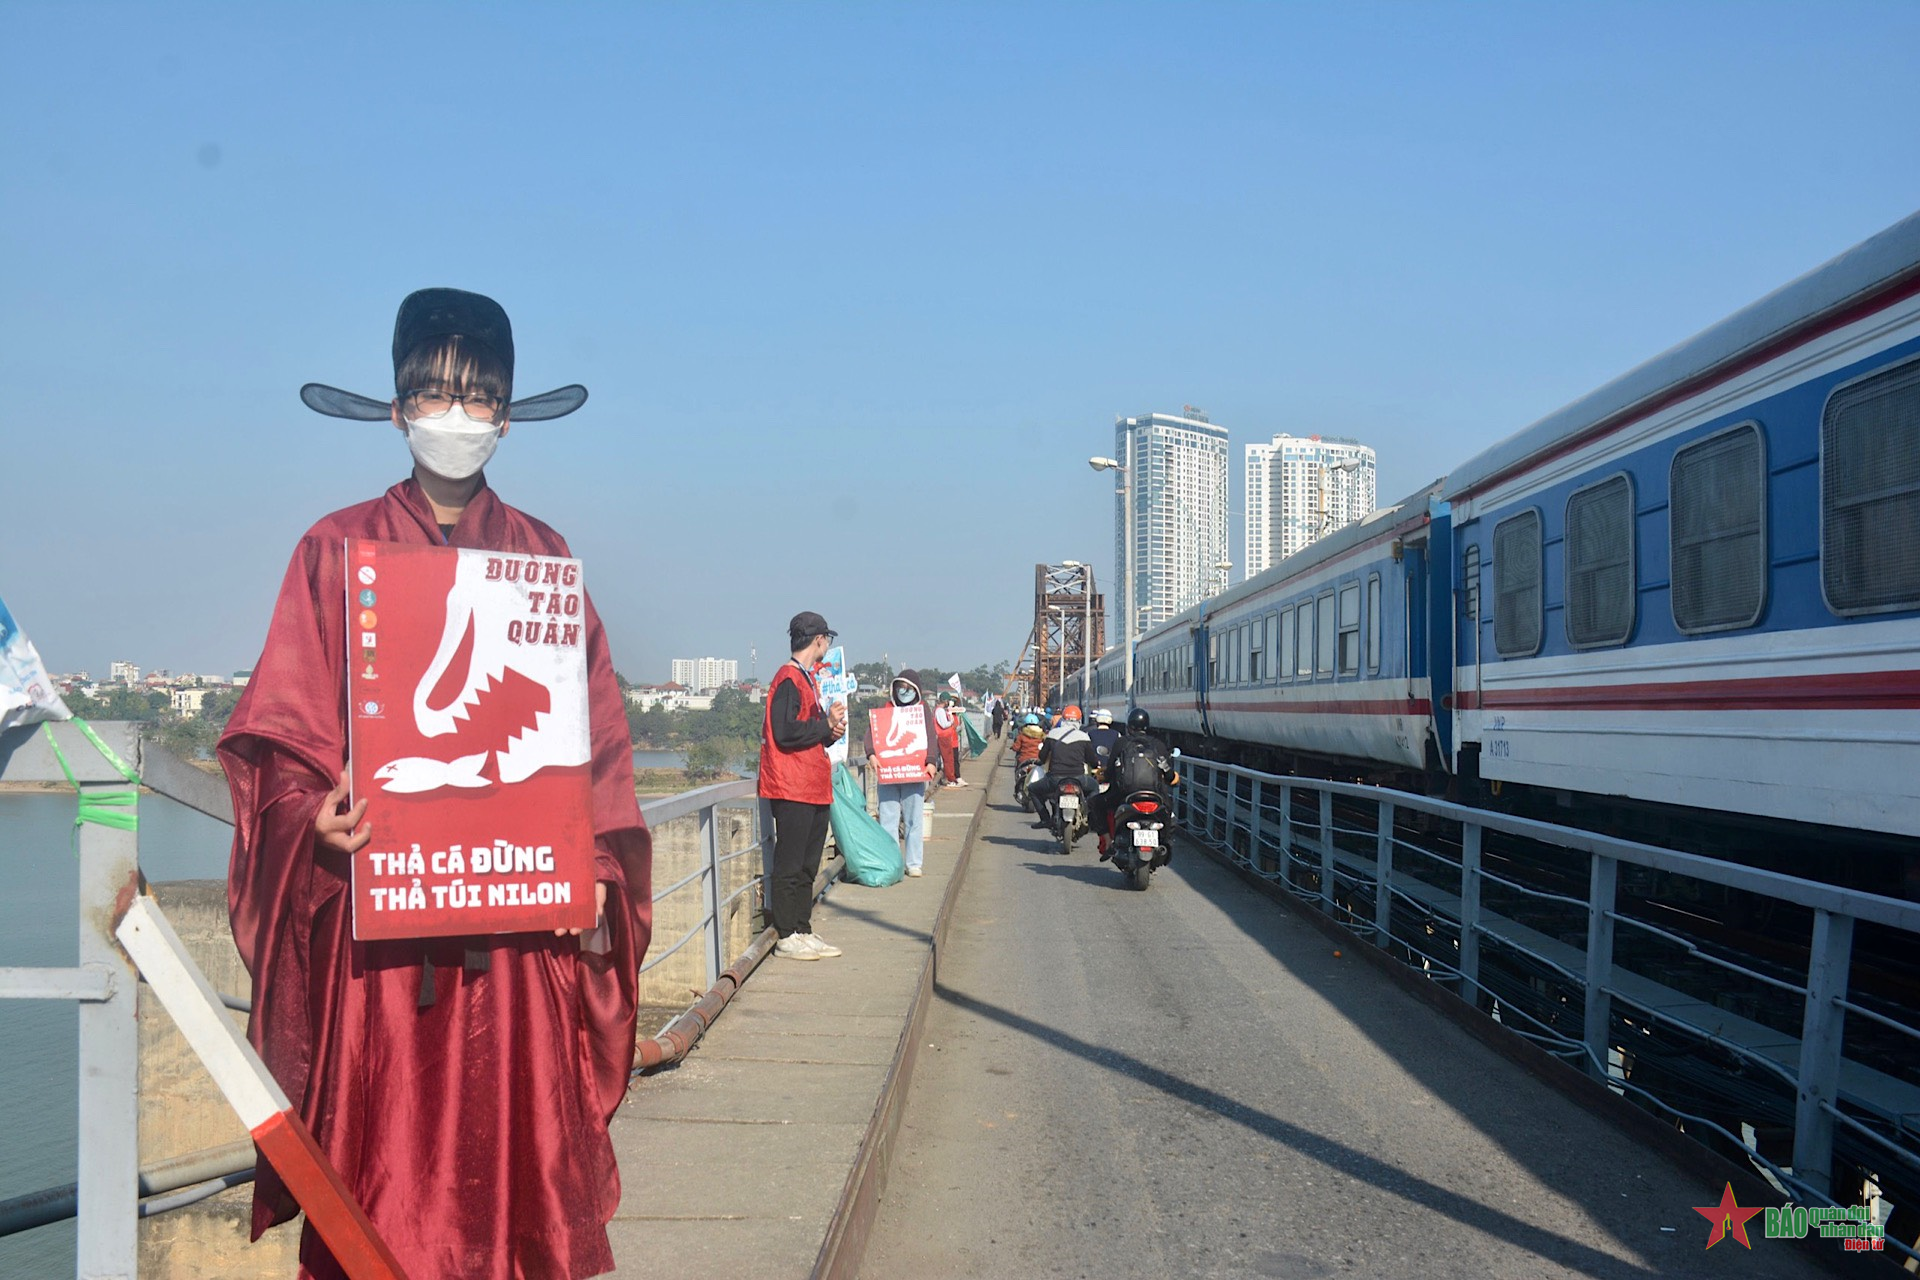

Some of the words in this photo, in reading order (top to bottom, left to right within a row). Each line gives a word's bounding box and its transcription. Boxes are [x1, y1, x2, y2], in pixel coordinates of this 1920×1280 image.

[528, 586, 579, 616] TÁO
[507, 616, 580, 646] QUÂN
[369, 843, 425, 876] THẢ
[431, 844, 465, 875] CÁ
[470, 839, 555, 874] ĐỪNG
[370, 878, 427, 911] THẢ
[431, 879, 482, 909] TÚI
[487, 881, 571, 907] NILON
